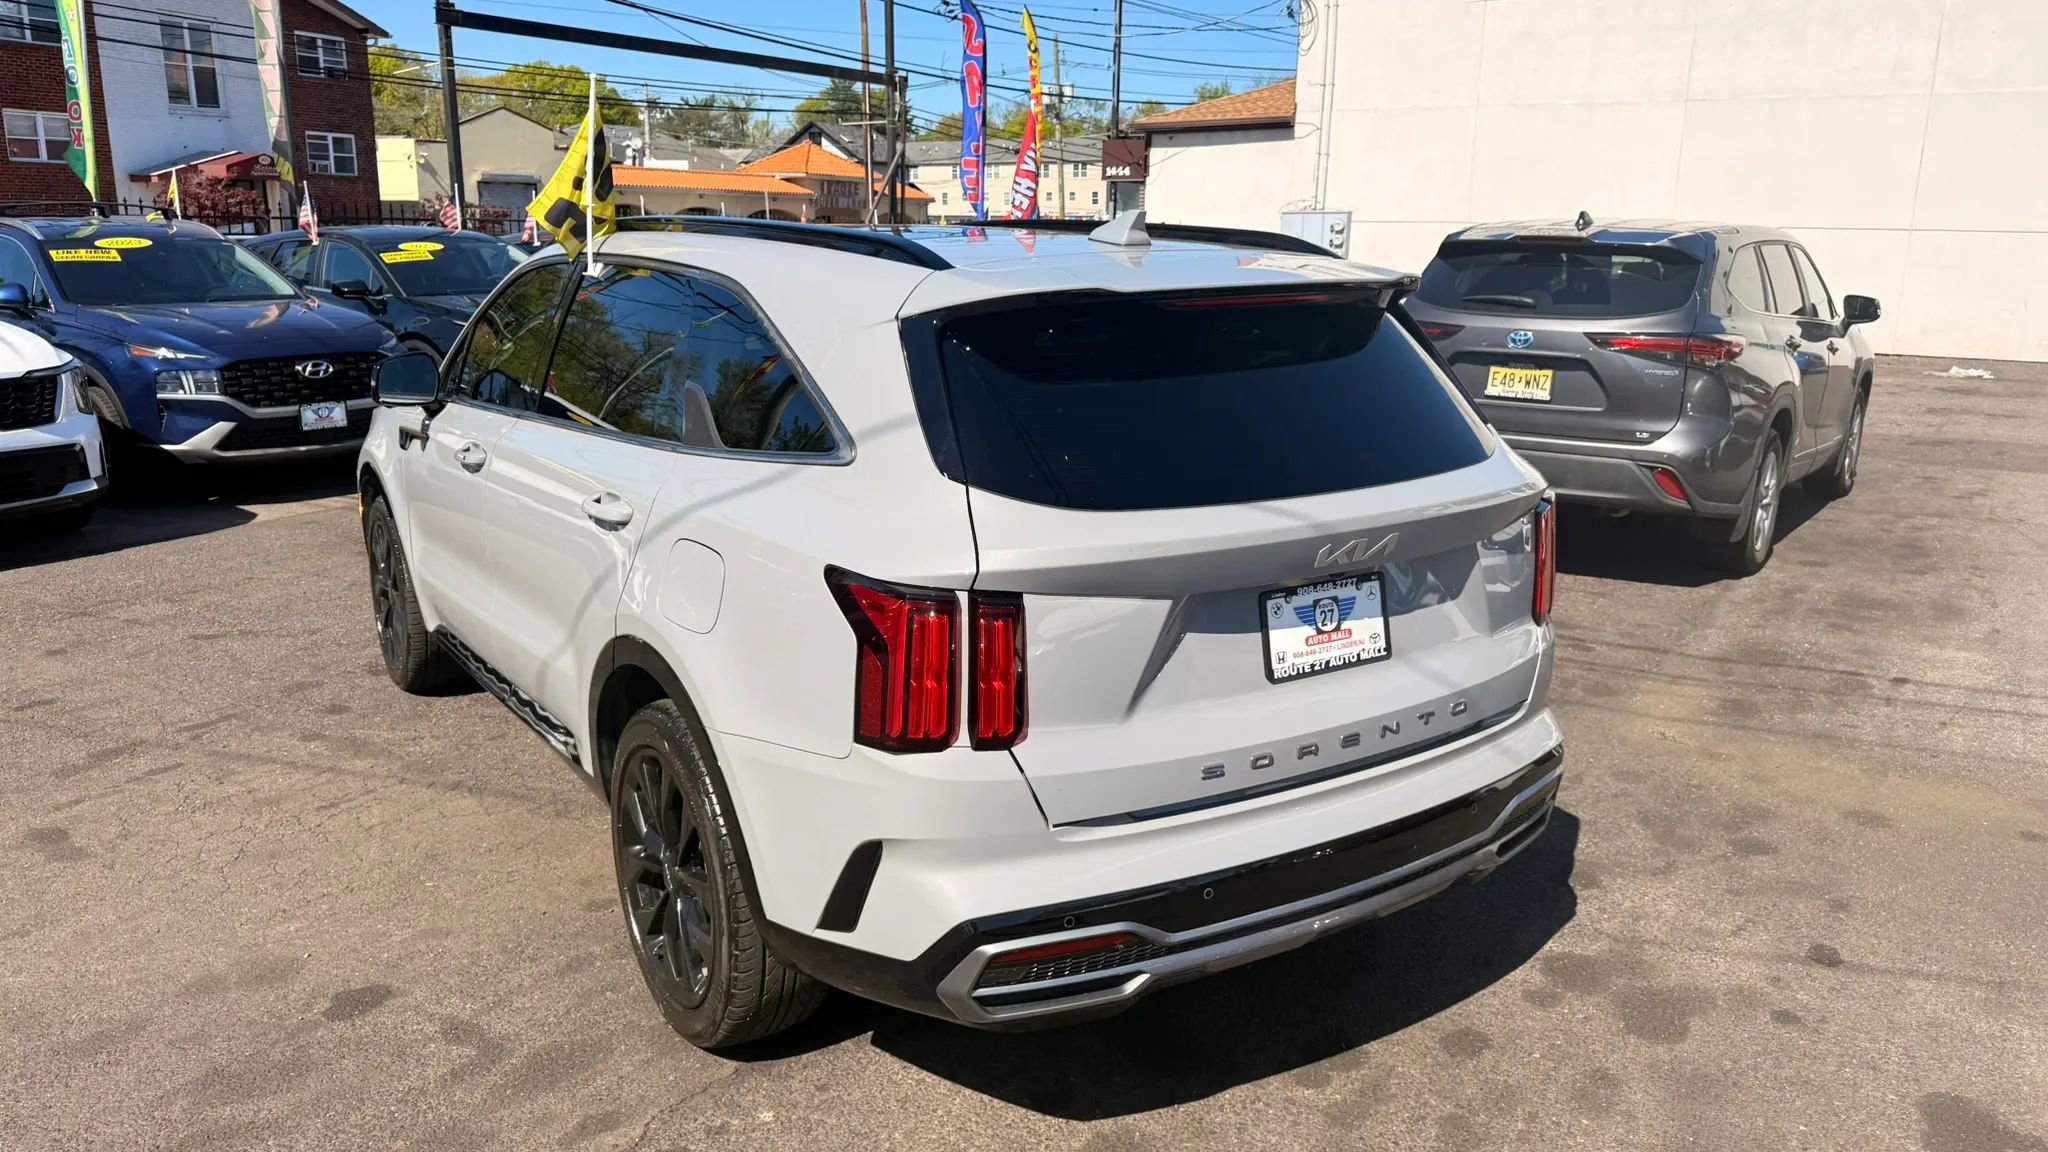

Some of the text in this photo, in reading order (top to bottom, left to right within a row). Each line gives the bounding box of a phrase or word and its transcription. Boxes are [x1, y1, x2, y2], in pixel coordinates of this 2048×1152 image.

[1491, 371, 1549, 391] E48 WNZ
[1314, 533, 1400, 568] KIA
[1297, 578, 1357, 596] 908-648-2727
[1319, 602, 1335, 610] ROUTE
[1320, 608, 1335, 628] 27
[1308, 631, 1350, 645] AUTO MALL
[1273, 646, 1388, 680] ROUTE 27 AUTO MALL
[1200, 699, 1468, 781] SORENTO
